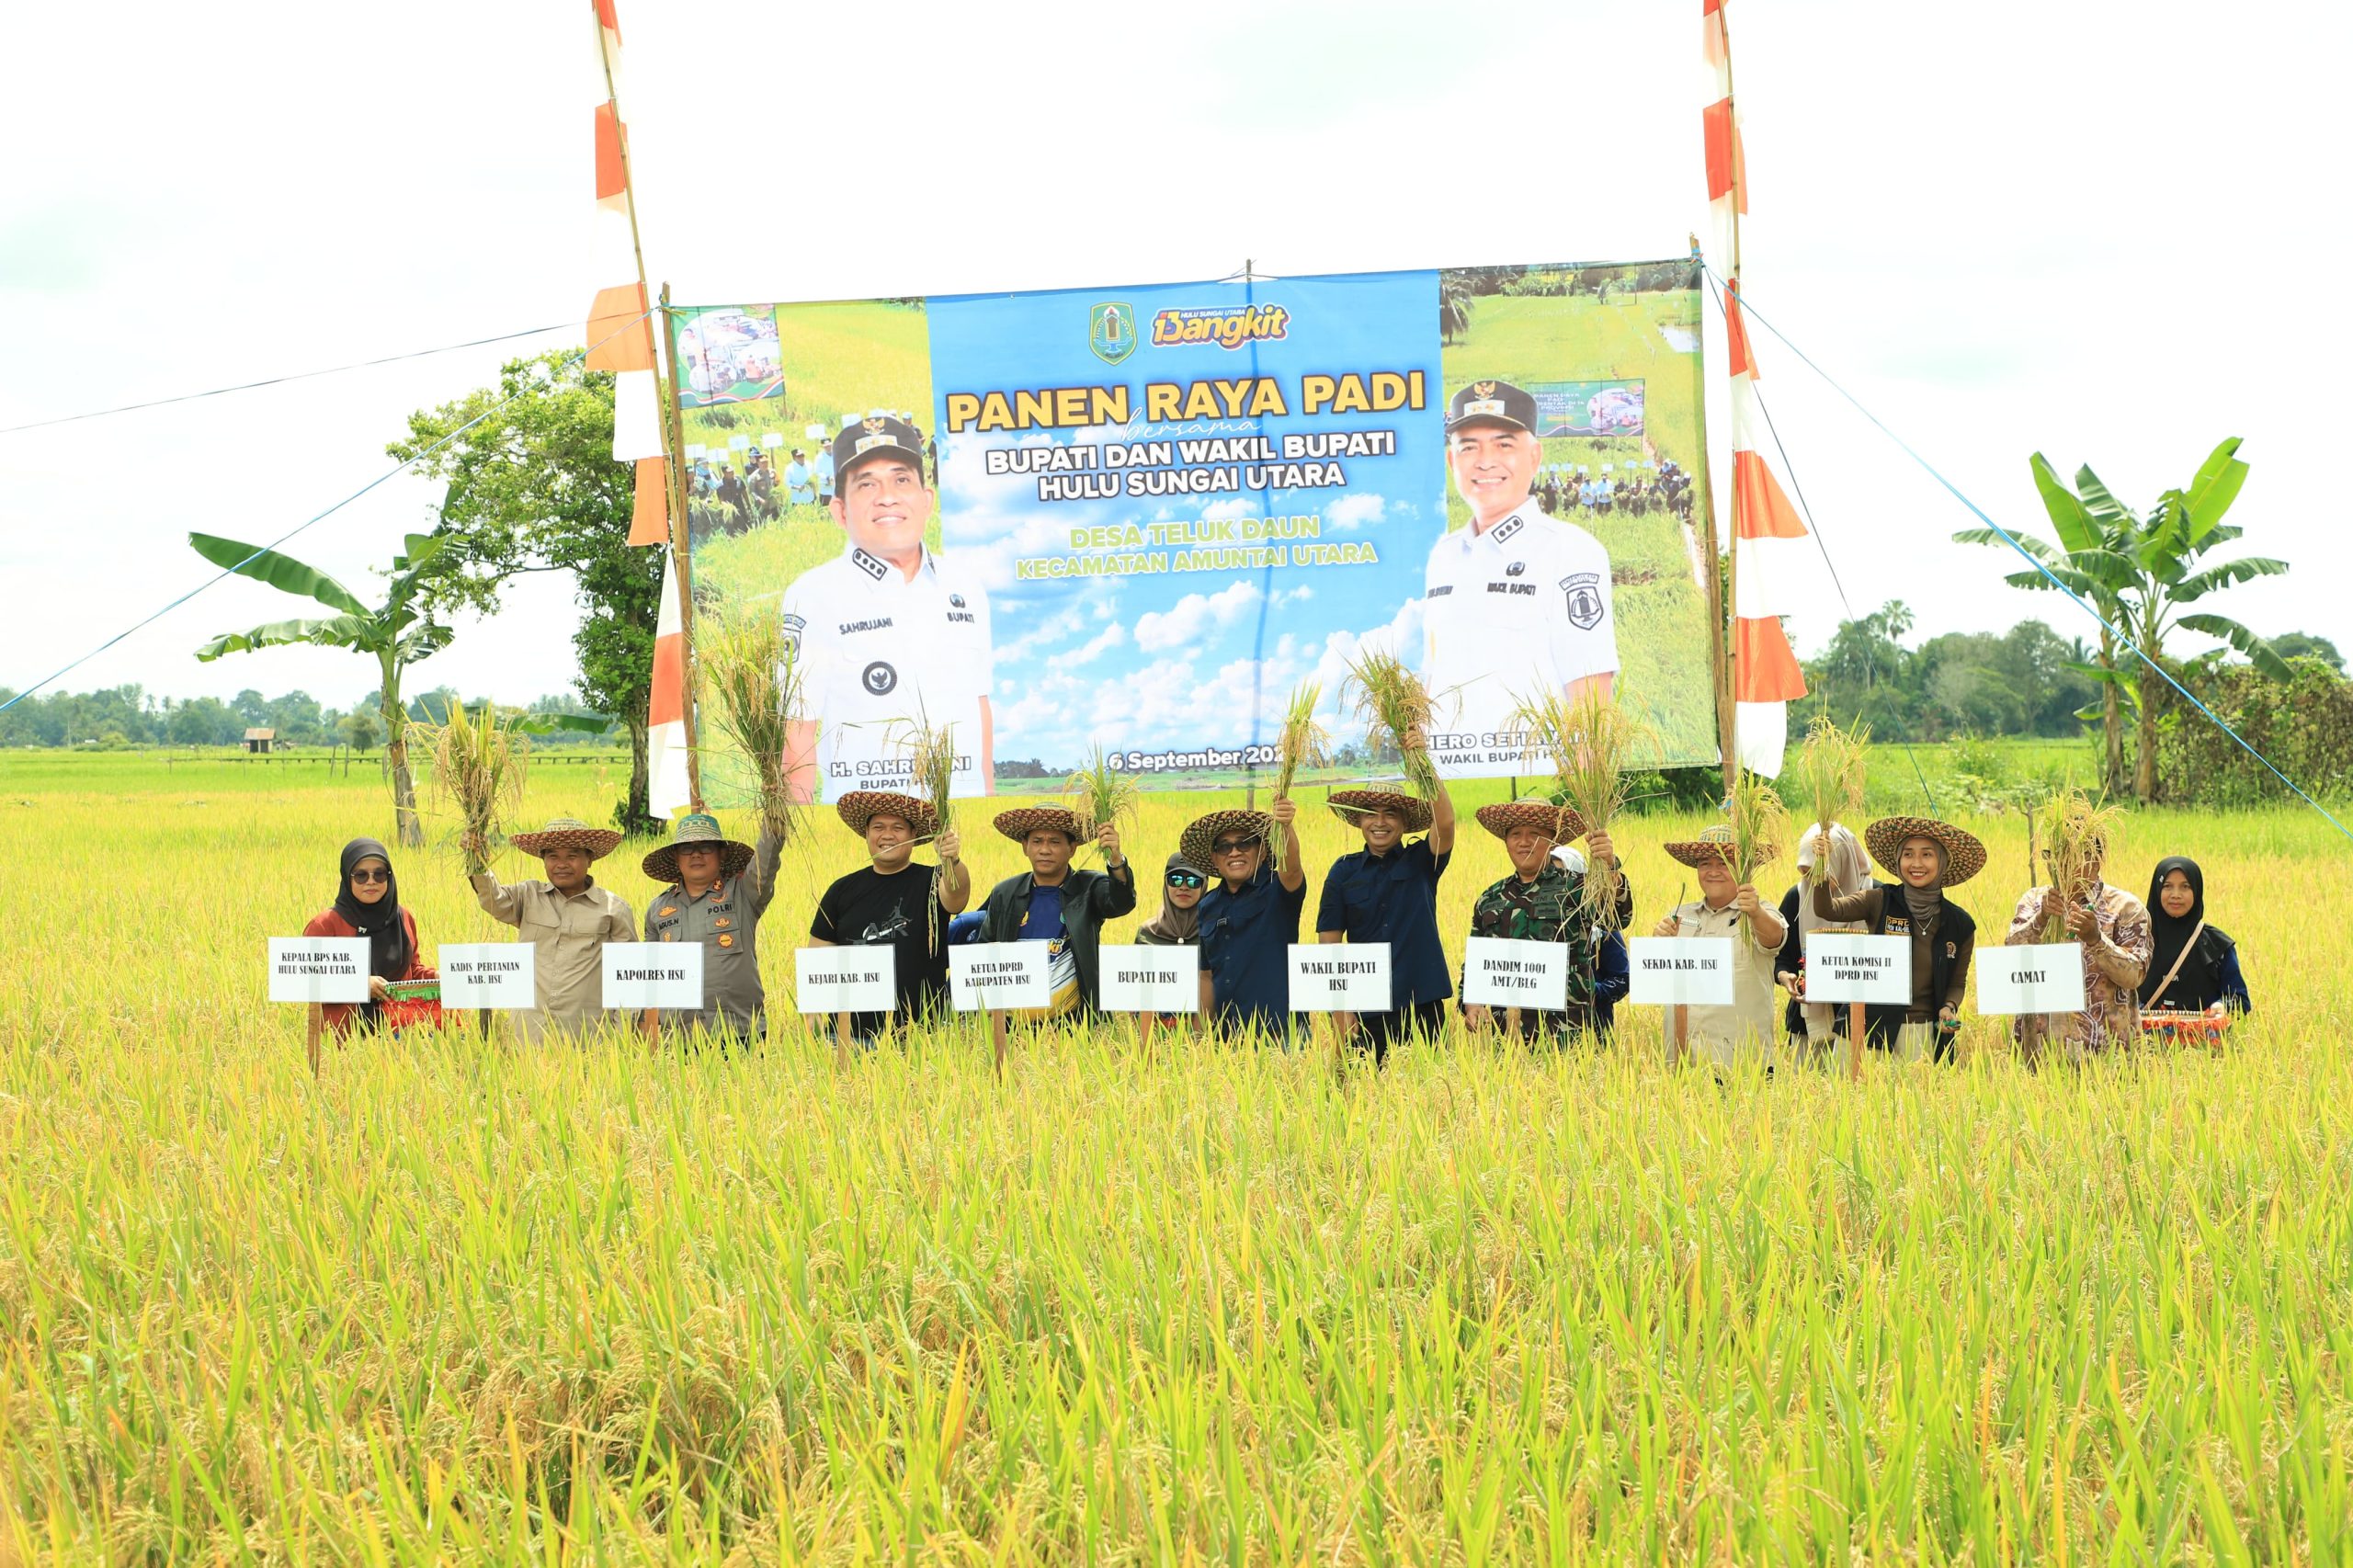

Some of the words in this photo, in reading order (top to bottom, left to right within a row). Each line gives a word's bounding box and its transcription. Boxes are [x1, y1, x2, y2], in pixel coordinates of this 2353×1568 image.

[946, 385, 1130, 434] PANEN
[1145, 377, 1290, 422] RAYA
[1302, 370, 1426, 415] PADI
[1120, 406, 1262, 442] bersama
[985, 443, 1098, 474] BUPATI
[1105, 440, 1172, 469] DAN
[1177, 436, 1277, 464] WAKIL
[1283, 430, 1395, 460] BUPATI
[1038, 472, 1120, 501] HULU
[1126, 467, 1239, 496] SUNGAI
[1245, 461, 1347, 491] UTARA
[1069, 525, 1144, 550] DESA
[1147, 519, 1235, 545] TELUK
[1241, 516, 1321, 540] DAUN
[1015, 552, 1168, 580] KECAMATAN
[1173, 546, 1287, 572] AMUNTAI
[1292, 542, 1379, 566] UTARA
[947, 612, 975, 624] BUPATI
[1127, 747, 1244, 772] September
[1439, 753, 1484, 765] WAKIL
[831, 762, 853, 778] H.
[707, 903, 733, 915] POLRI
[281, 952, 312, 962] KEPALA
[313, 952, 330, 961] BPS
[333, 952, 352, 961] KAB.
[1822, 956, 1849, 966] KETUA
[1851, 956, 1881, 967] KOMISI
[1884, 957, 1892, 967] II
[278, 965, 298, 974] HULU
[300, 965, 327, 974] SUNGAI
[329, 965, 357, 974] UTARA
[450, 962, 472, 971] KADIS
[477, 961, 520, 971] PERTANIAN
[971, 963, 997, 974] KETUA
[999, 961, 1023, 972] DPRD
[1301, 962, 1335, 974] WAKIL
[1337, 961, 1376, 974] BUPATI
[1483, 959, 1521, 972] DANDIM
[1524, 961, 1546, 974] 1001
[1642, 959, 1672, 970] SEKDA
[1675, 959, 1698, 970] KAB.
[1700, 959, 1718, 970] HSU
[468, 974, 486, 984] KAB.
[488, 974, 503, 983] HSU
[616, 969, 665, 981] KAPOLRES
[667, 969, 686, 981] HSU
[809, 973, 838, 985] KEJARI
[840, 972, 861, 983] KAB.
[864, 971, 881, 983] HSU
[965, 975, 1013, 987] KABUPATEN
[1016, 974, 1031, 984] HSU
[1118, 971, 1156, 983] BUPATI
[1159, 971, 1177, 983] HSU
[1835, 970, 1860, 981] DPRD
[1862, 970, 1879, 981] HSU
[2011, 970, 2047, 983] CAMAT
[1329, 978, 1348, 991] HSU
[1491, 975, 1537, 989] AMT/BLG
